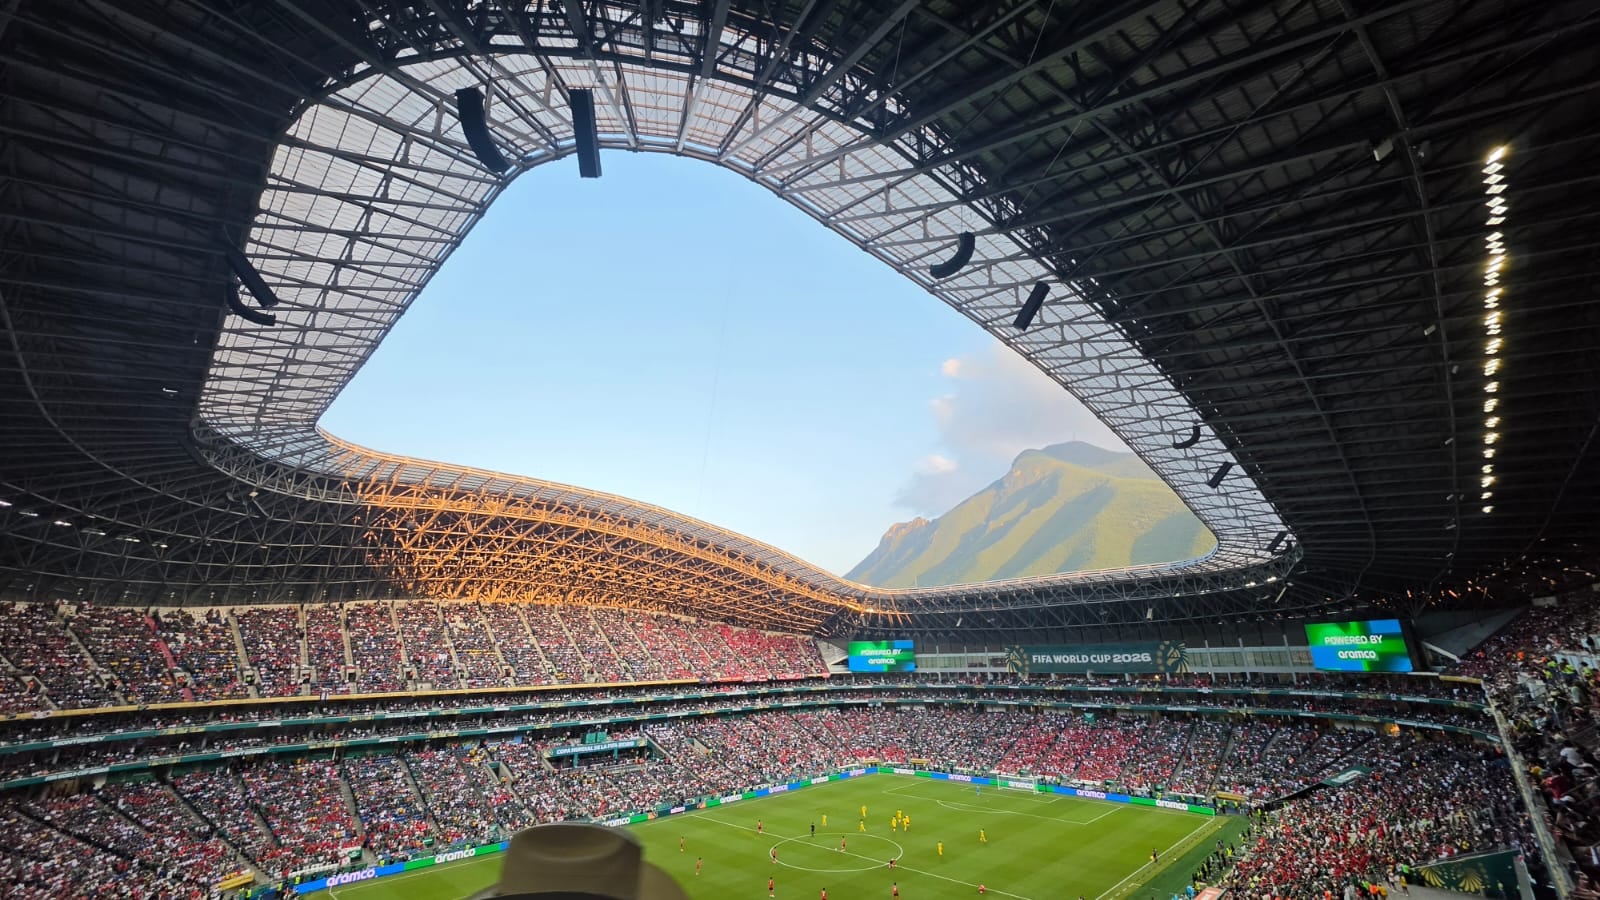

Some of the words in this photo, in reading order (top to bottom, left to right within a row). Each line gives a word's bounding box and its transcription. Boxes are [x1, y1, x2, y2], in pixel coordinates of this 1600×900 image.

[1324, 636, 1368, 645] POWERED
[1369, 635, 1383, 644] BY
[1032, 655, 1052, 664] FIFA
[1053, 654, 1089, 663] WORLD
[1090, 654, 1111, 663] CUP
[1112, 653, 1151, 663] 2026
[1338, 650, 1376, 659] aramco
[1076, 789, 1106, 799] aramco
[1156, 800, 1189, 811] aramco
[435, 848, 476, 864] aramco
[326, 867, 376, 887] aramco
